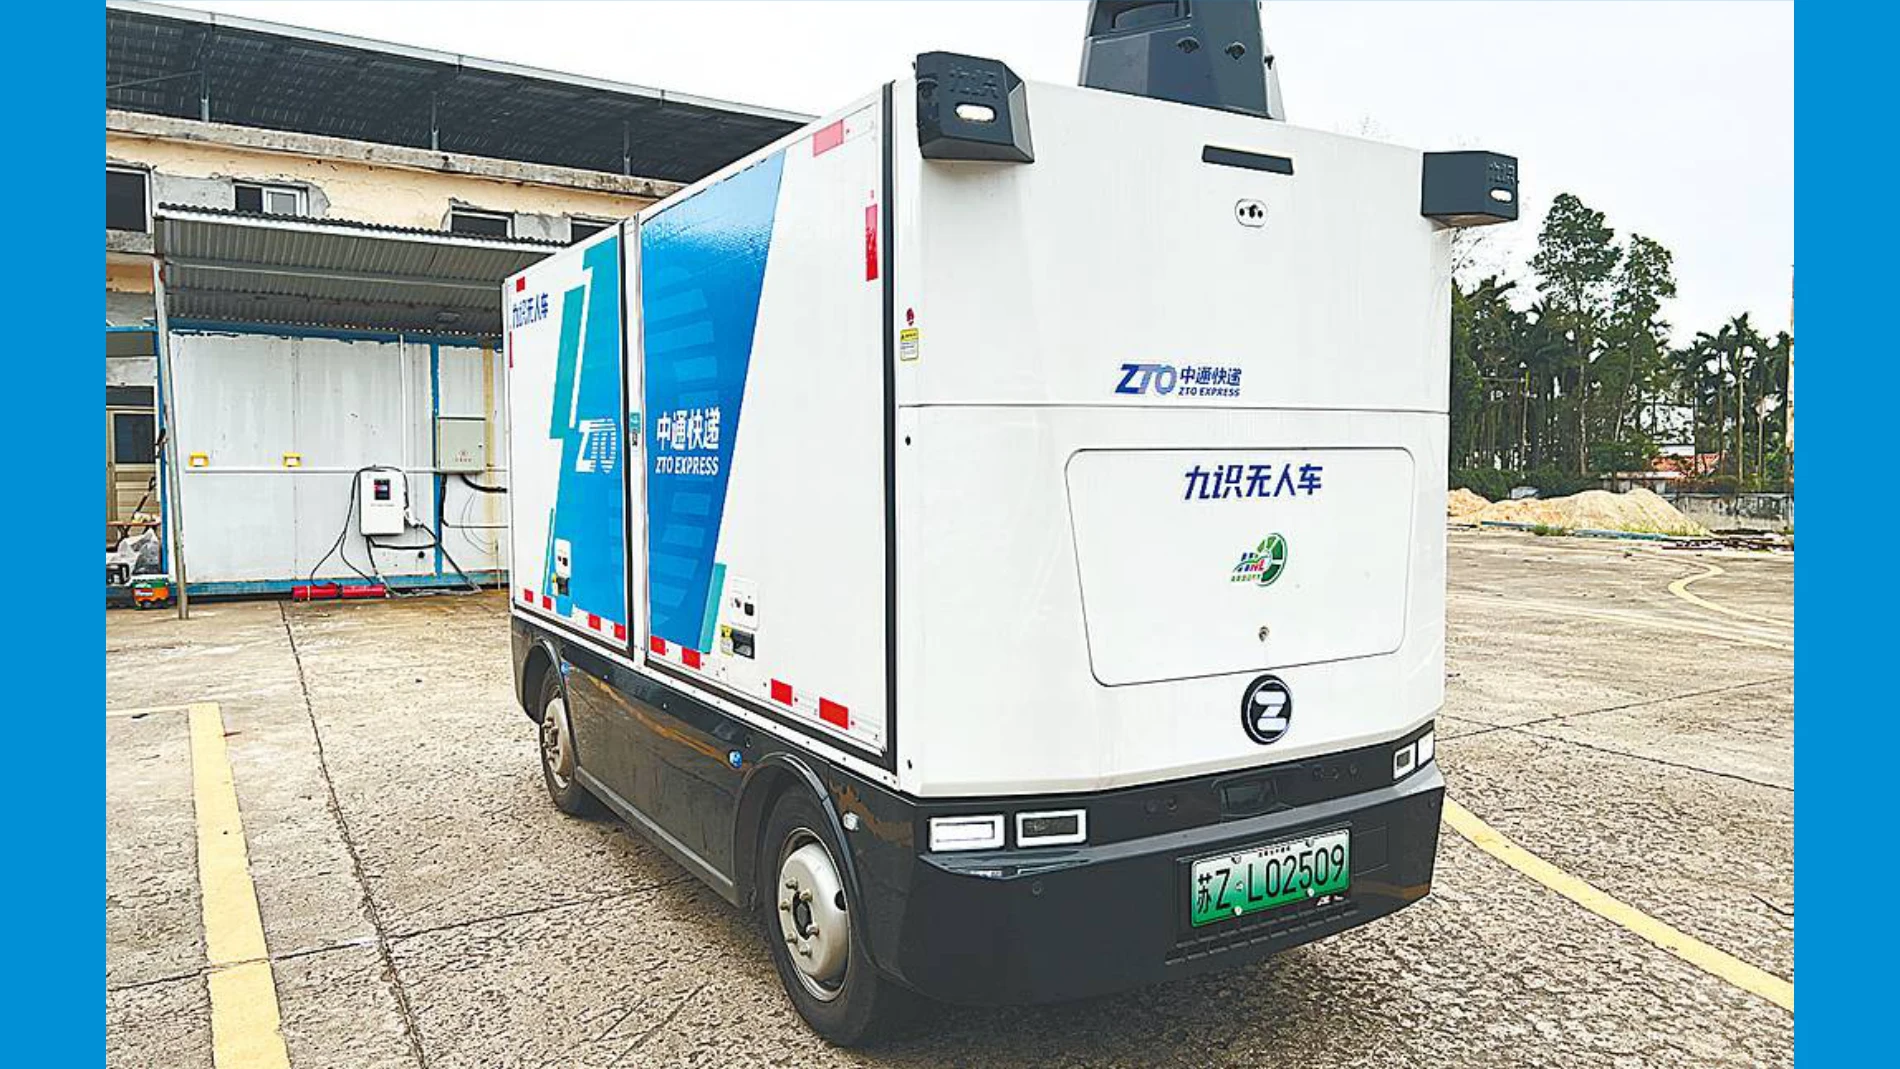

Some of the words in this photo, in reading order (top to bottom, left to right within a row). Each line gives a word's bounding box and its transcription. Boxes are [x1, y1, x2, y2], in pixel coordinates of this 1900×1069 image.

[1115, 363, 1177, 395] ZTO
[1178, 387, 1198, 396] ZTO
[1199, 387, 1240, 397] EXPRESS
[1180, 366, 1242, 387] 中通快递
[656, 406, 721, 451] 中通快递
[575, 418, 617, 474] ZTO
[655, 456, 674, 474] ZTO
[674, 456, 719, 476] EXPRESS
[1184, 463, 1323, 500] 九识无人车
